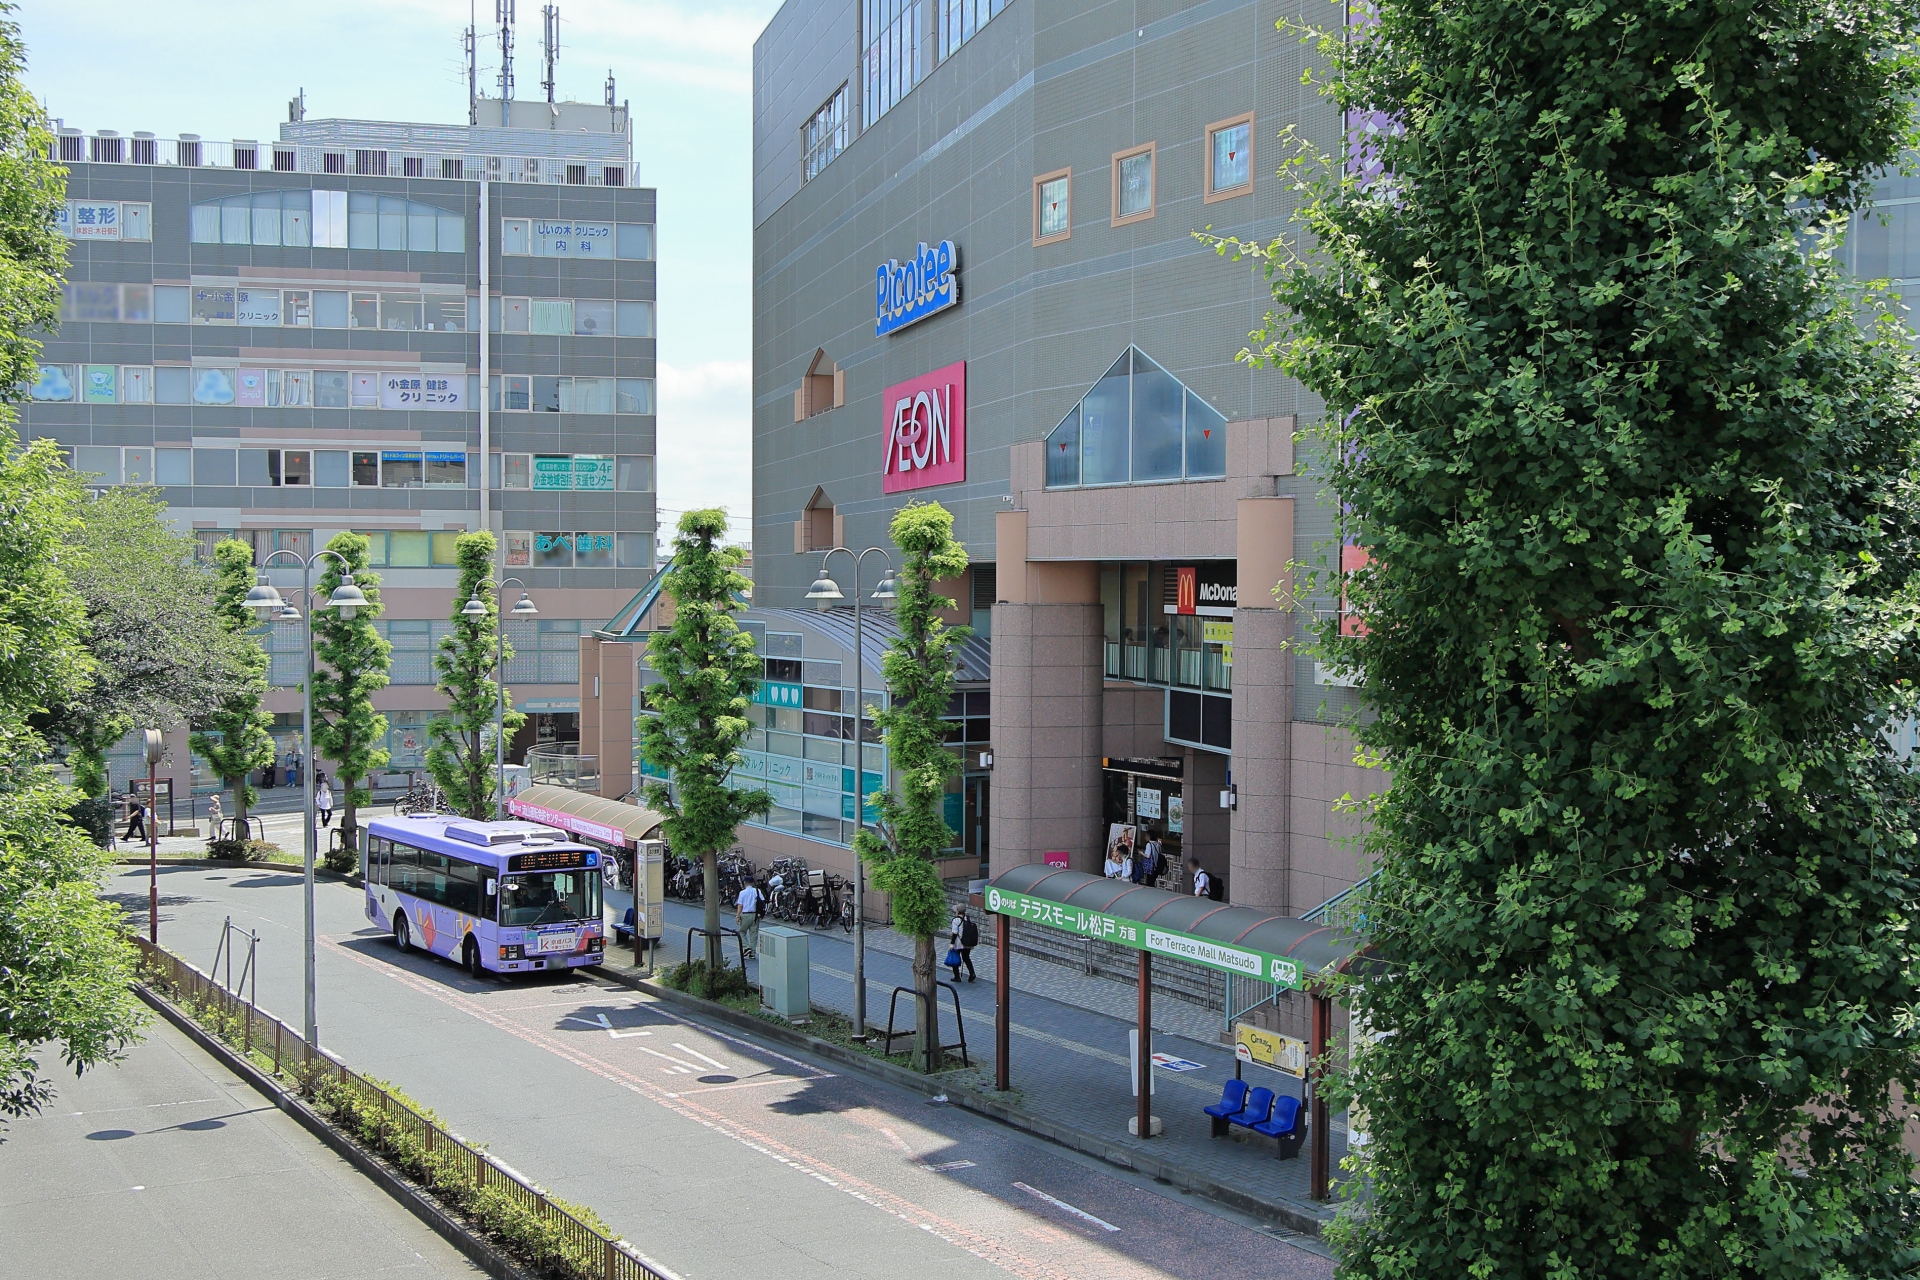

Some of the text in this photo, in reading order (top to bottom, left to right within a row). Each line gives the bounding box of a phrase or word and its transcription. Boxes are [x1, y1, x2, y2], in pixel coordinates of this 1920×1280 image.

[877, 241, 954, 327] Picotee
[400, 391, 458, 403] クリニック
[599, 462, 612, 474] 4F
[534, 534, 613, 552] あべ歯科
[1001, 898, 1017, 910] のりば
[1020, 898, 1116, 938] テラスモール松戸
[1118, 924, 1137, 942] 方面
[1150, 933, 1164, 946] For
[1165, 937, 1196, 954] Terrace
[1197, 945, 1216, 960] Mall
[1218, 950, 1256, 970] Matsudo
